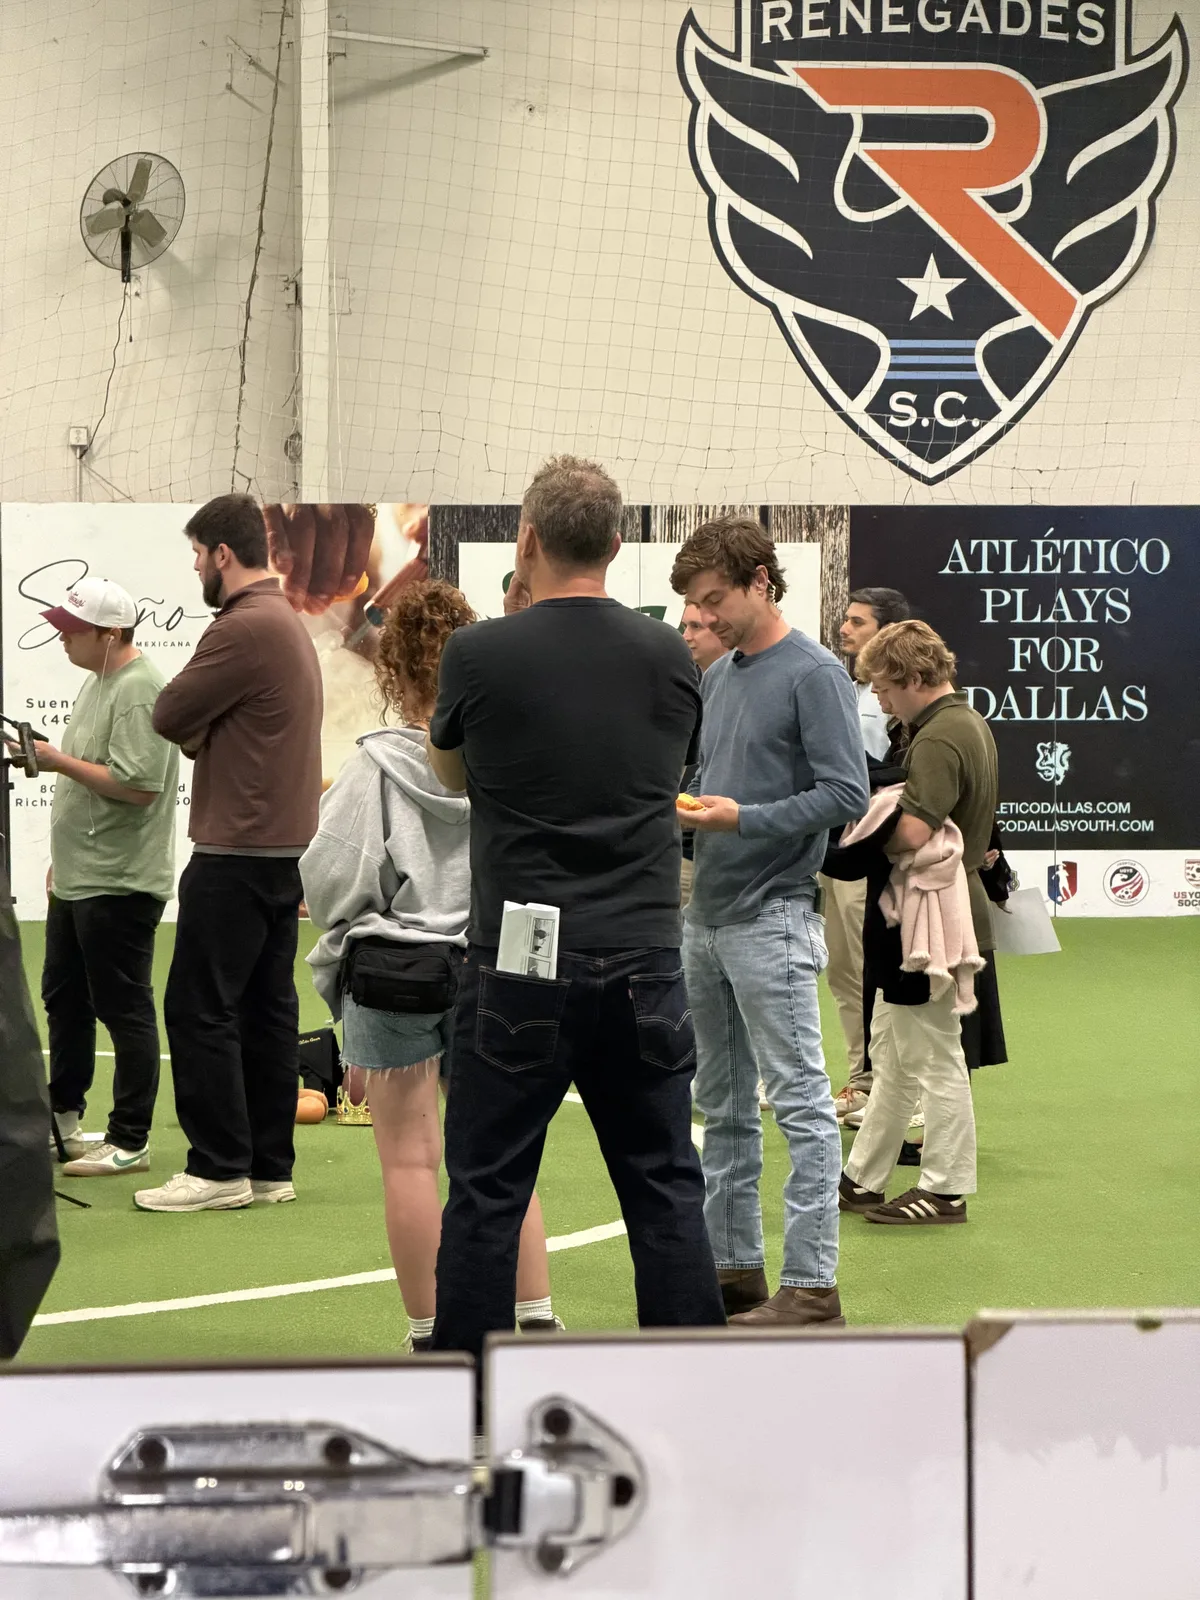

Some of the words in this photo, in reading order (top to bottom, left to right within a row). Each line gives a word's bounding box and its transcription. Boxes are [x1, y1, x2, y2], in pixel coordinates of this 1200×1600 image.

[761, 0, 1106, 46] RENEGADES
[888, 391, 980, 428] S.C.
[938, 527, 1171, 575] ATLÉTICO
[979, 588, 1132, 624] PLAYS
[1008, 636, 1103, 673] FOR
[962, 685, 1148, 721] DALLAS
